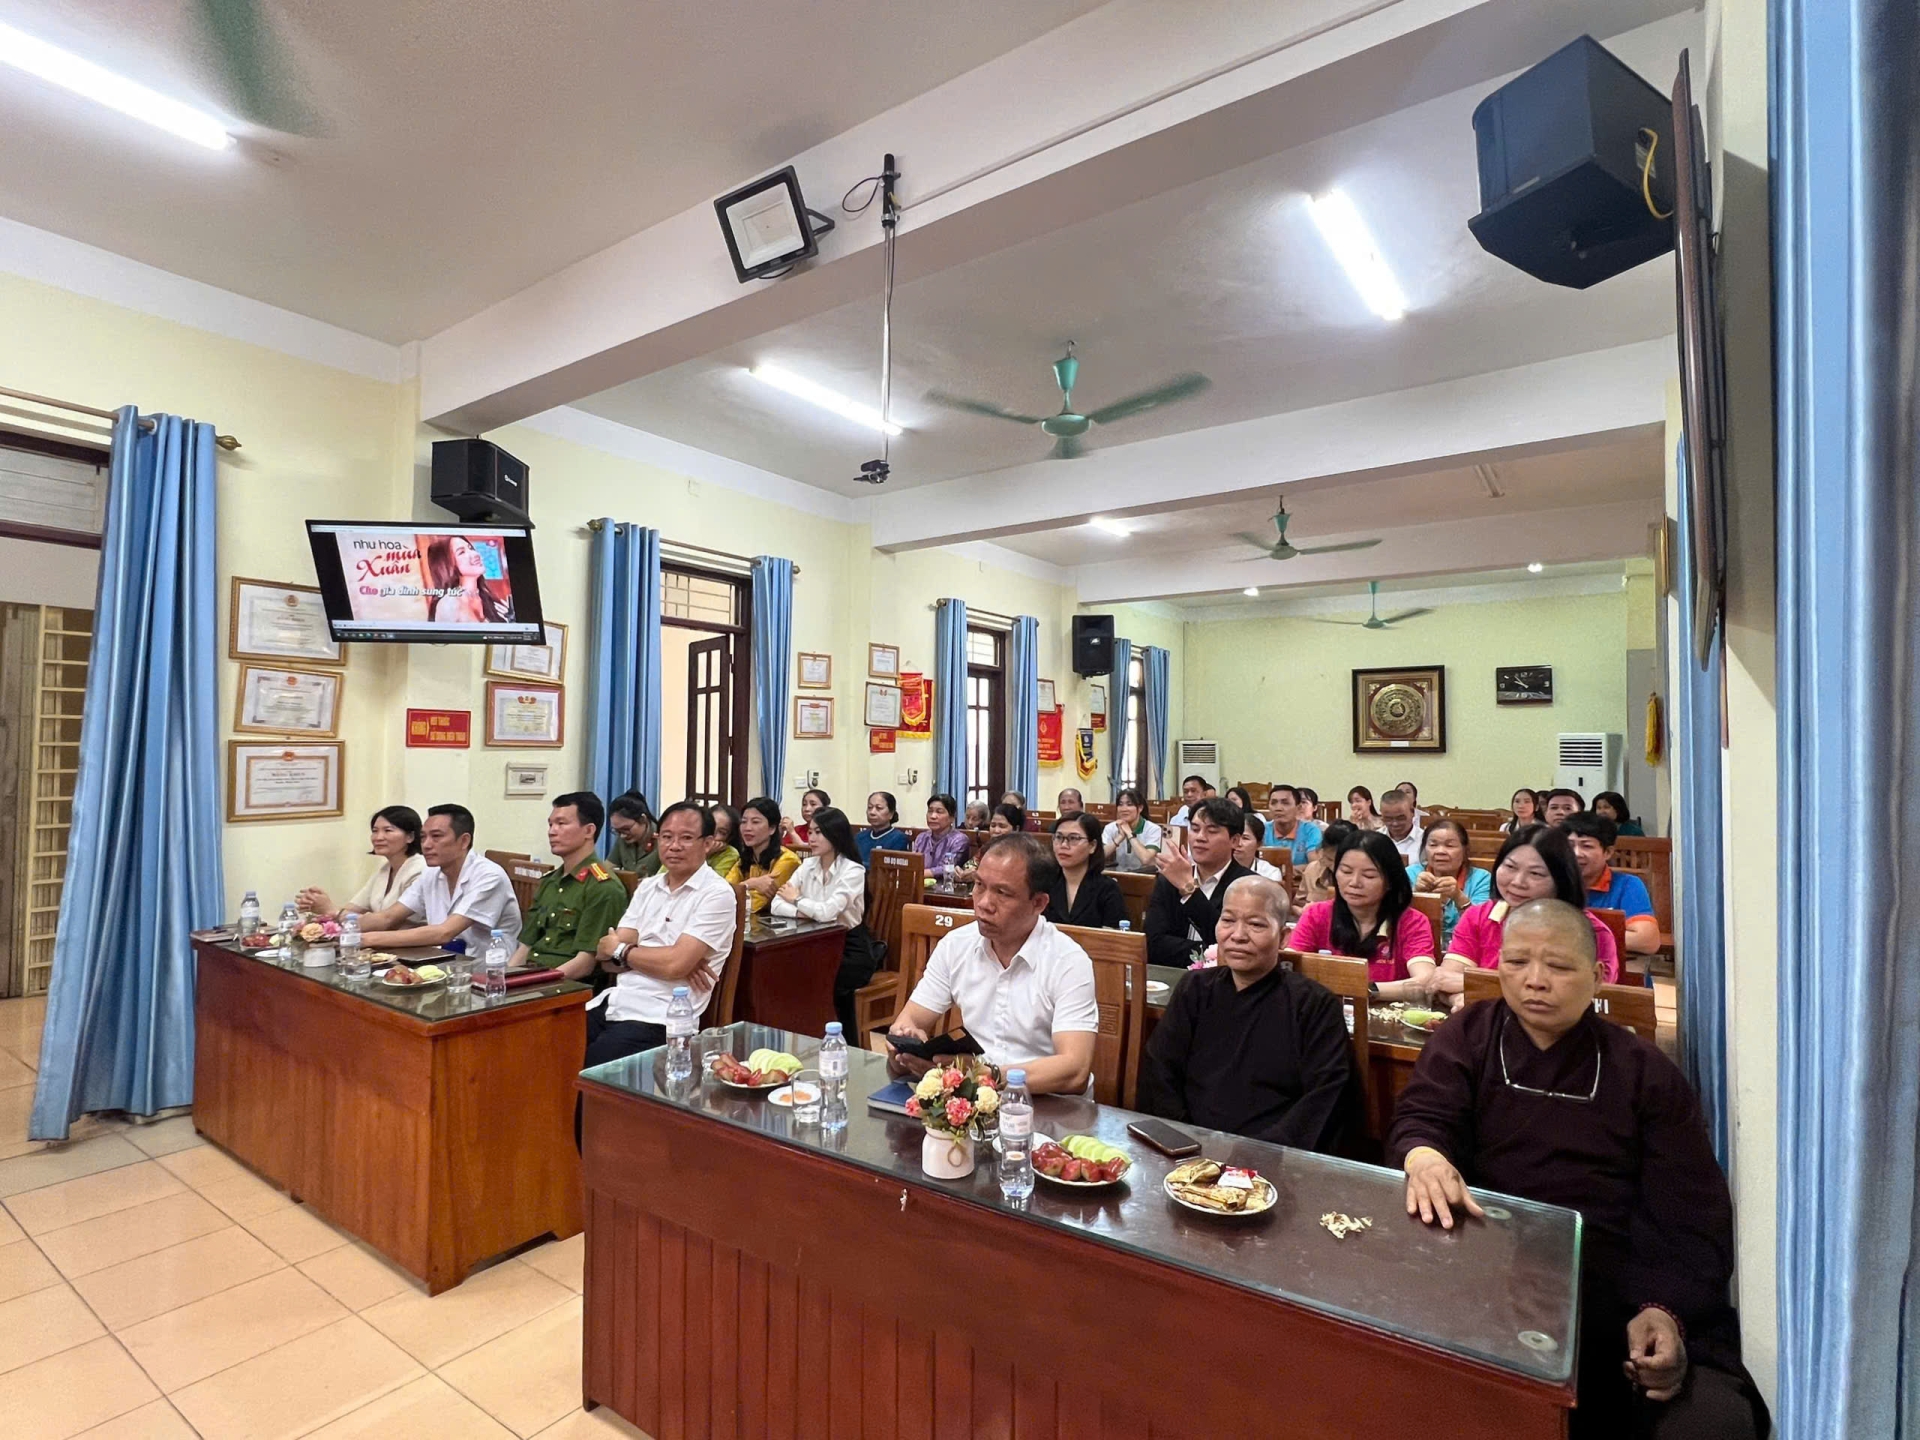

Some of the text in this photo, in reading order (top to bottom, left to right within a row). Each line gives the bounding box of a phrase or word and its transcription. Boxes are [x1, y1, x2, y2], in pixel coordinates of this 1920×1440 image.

[379, 540, 402, 550] hoa
[360, 586, 379, 595] Cho
[380, 586, 395, 597] gia
[422, 587, 445, 597] sung
[935, 914, 953, 927] 29
